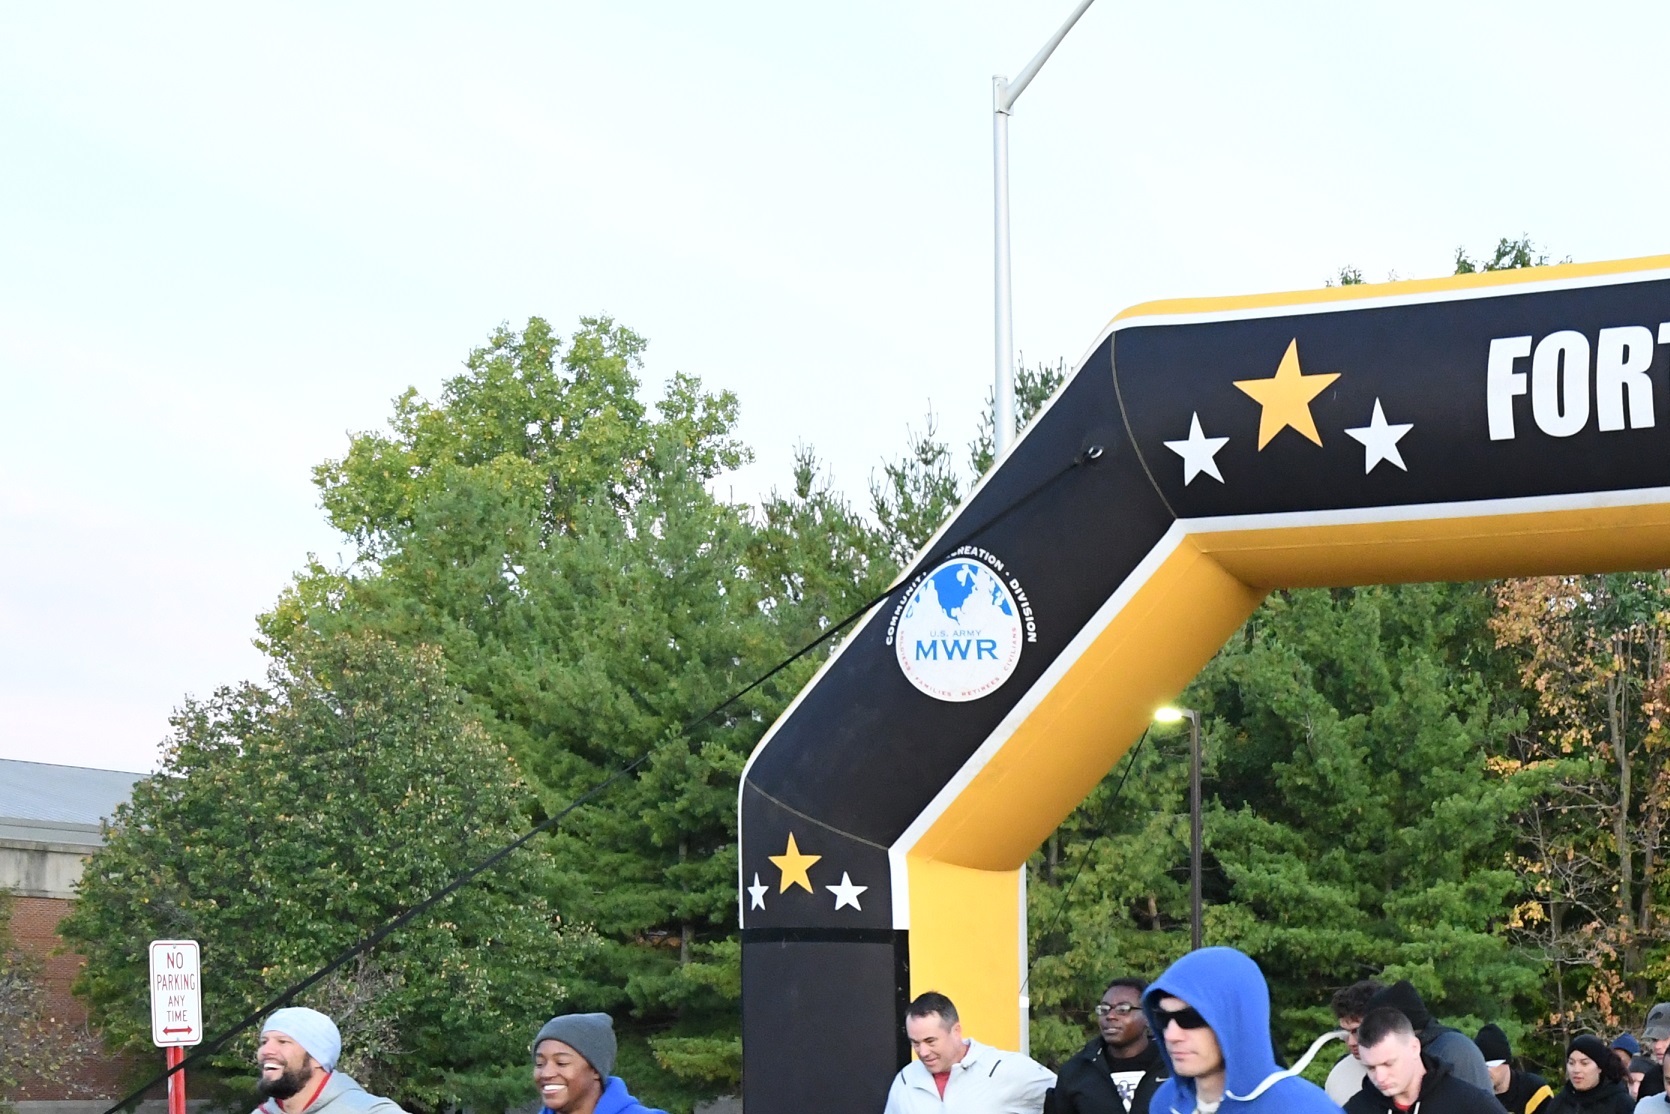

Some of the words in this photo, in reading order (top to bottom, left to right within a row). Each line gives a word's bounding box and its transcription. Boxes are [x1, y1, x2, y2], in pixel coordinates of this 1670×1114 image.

[886, 572, 927, 646] COMMUNIT
[1009, 578, 1037, 643] DIVISION
[930, 630, 949, 638] U.S.
[953, 629, 981, 637] ARMY
[916, 639, 999, 661] MWR
[961, 677, 1000, 697] RETIREES
[1003, 627, 1017, 672] CIVILIANS
[167, 952, 184, 969] NO
[156, 973, 196, 991] PARKING
[168, 995, 186, 1007] ANY
[167, 1010, 188, 1022] TIME
